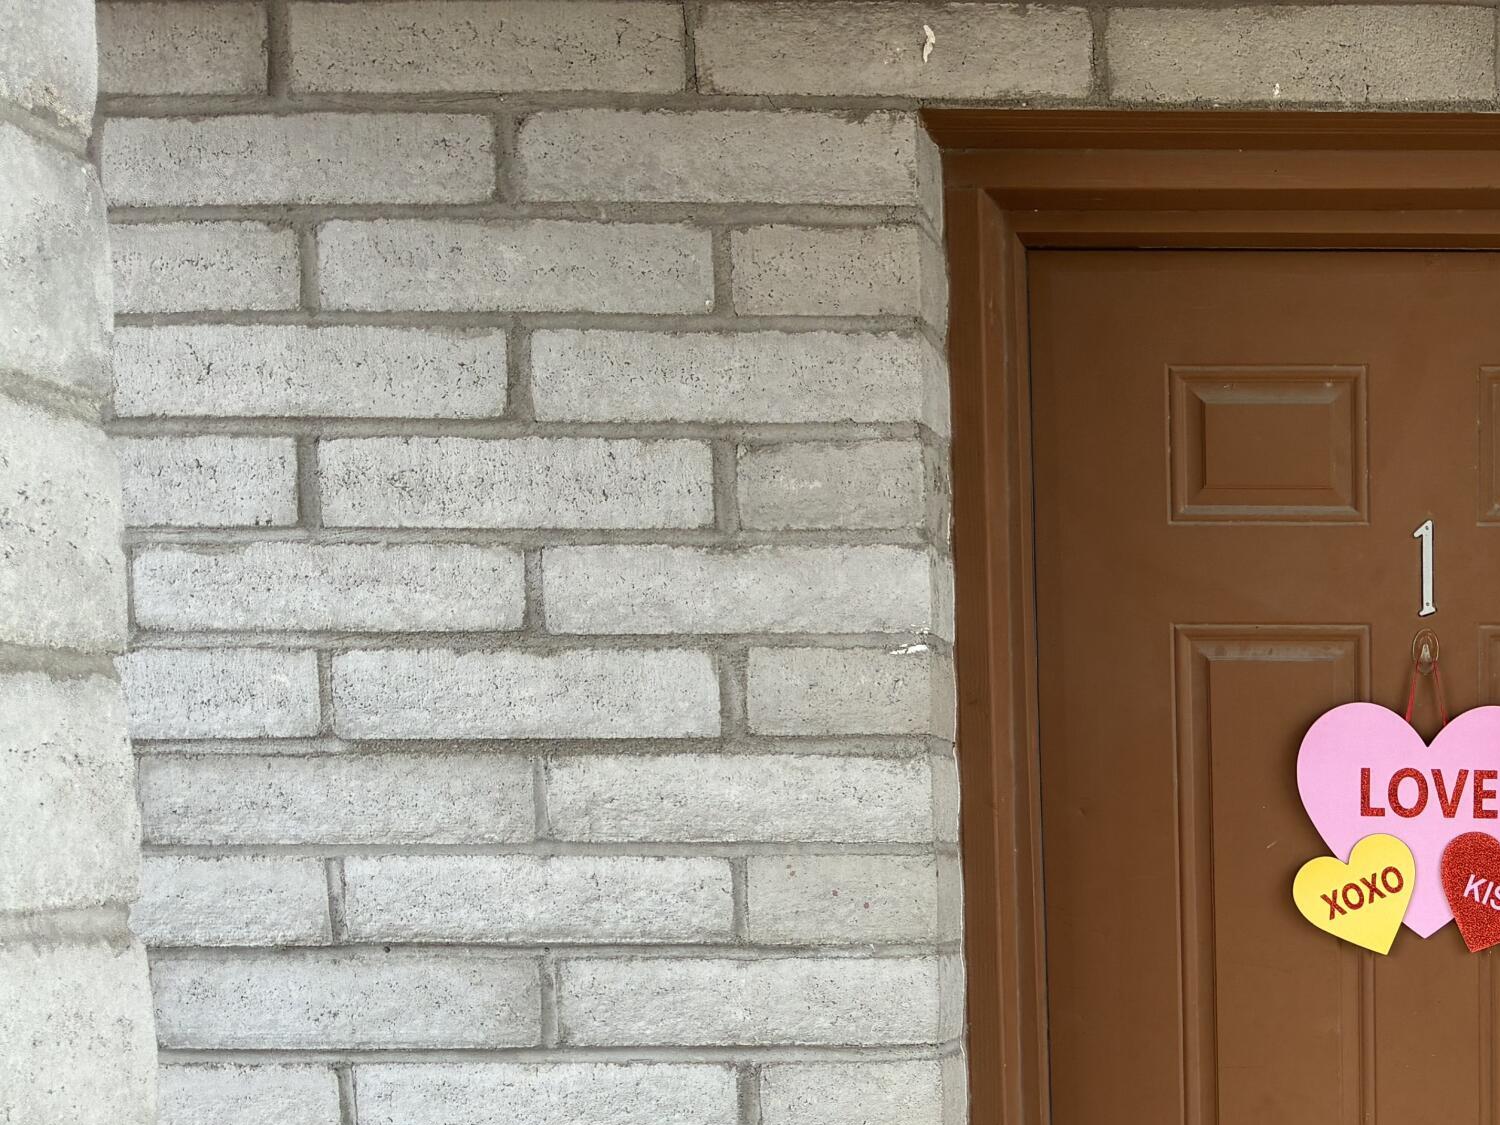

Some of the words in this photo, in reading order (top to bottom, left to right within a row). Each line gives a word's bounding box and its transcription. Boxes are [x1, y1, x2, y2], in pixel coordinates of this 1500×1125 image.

[1412, 519, 1437, 616] 1
[1360, 767, 1498, 819] LOVE
[1320, 866, 1404, 920] XOXO
